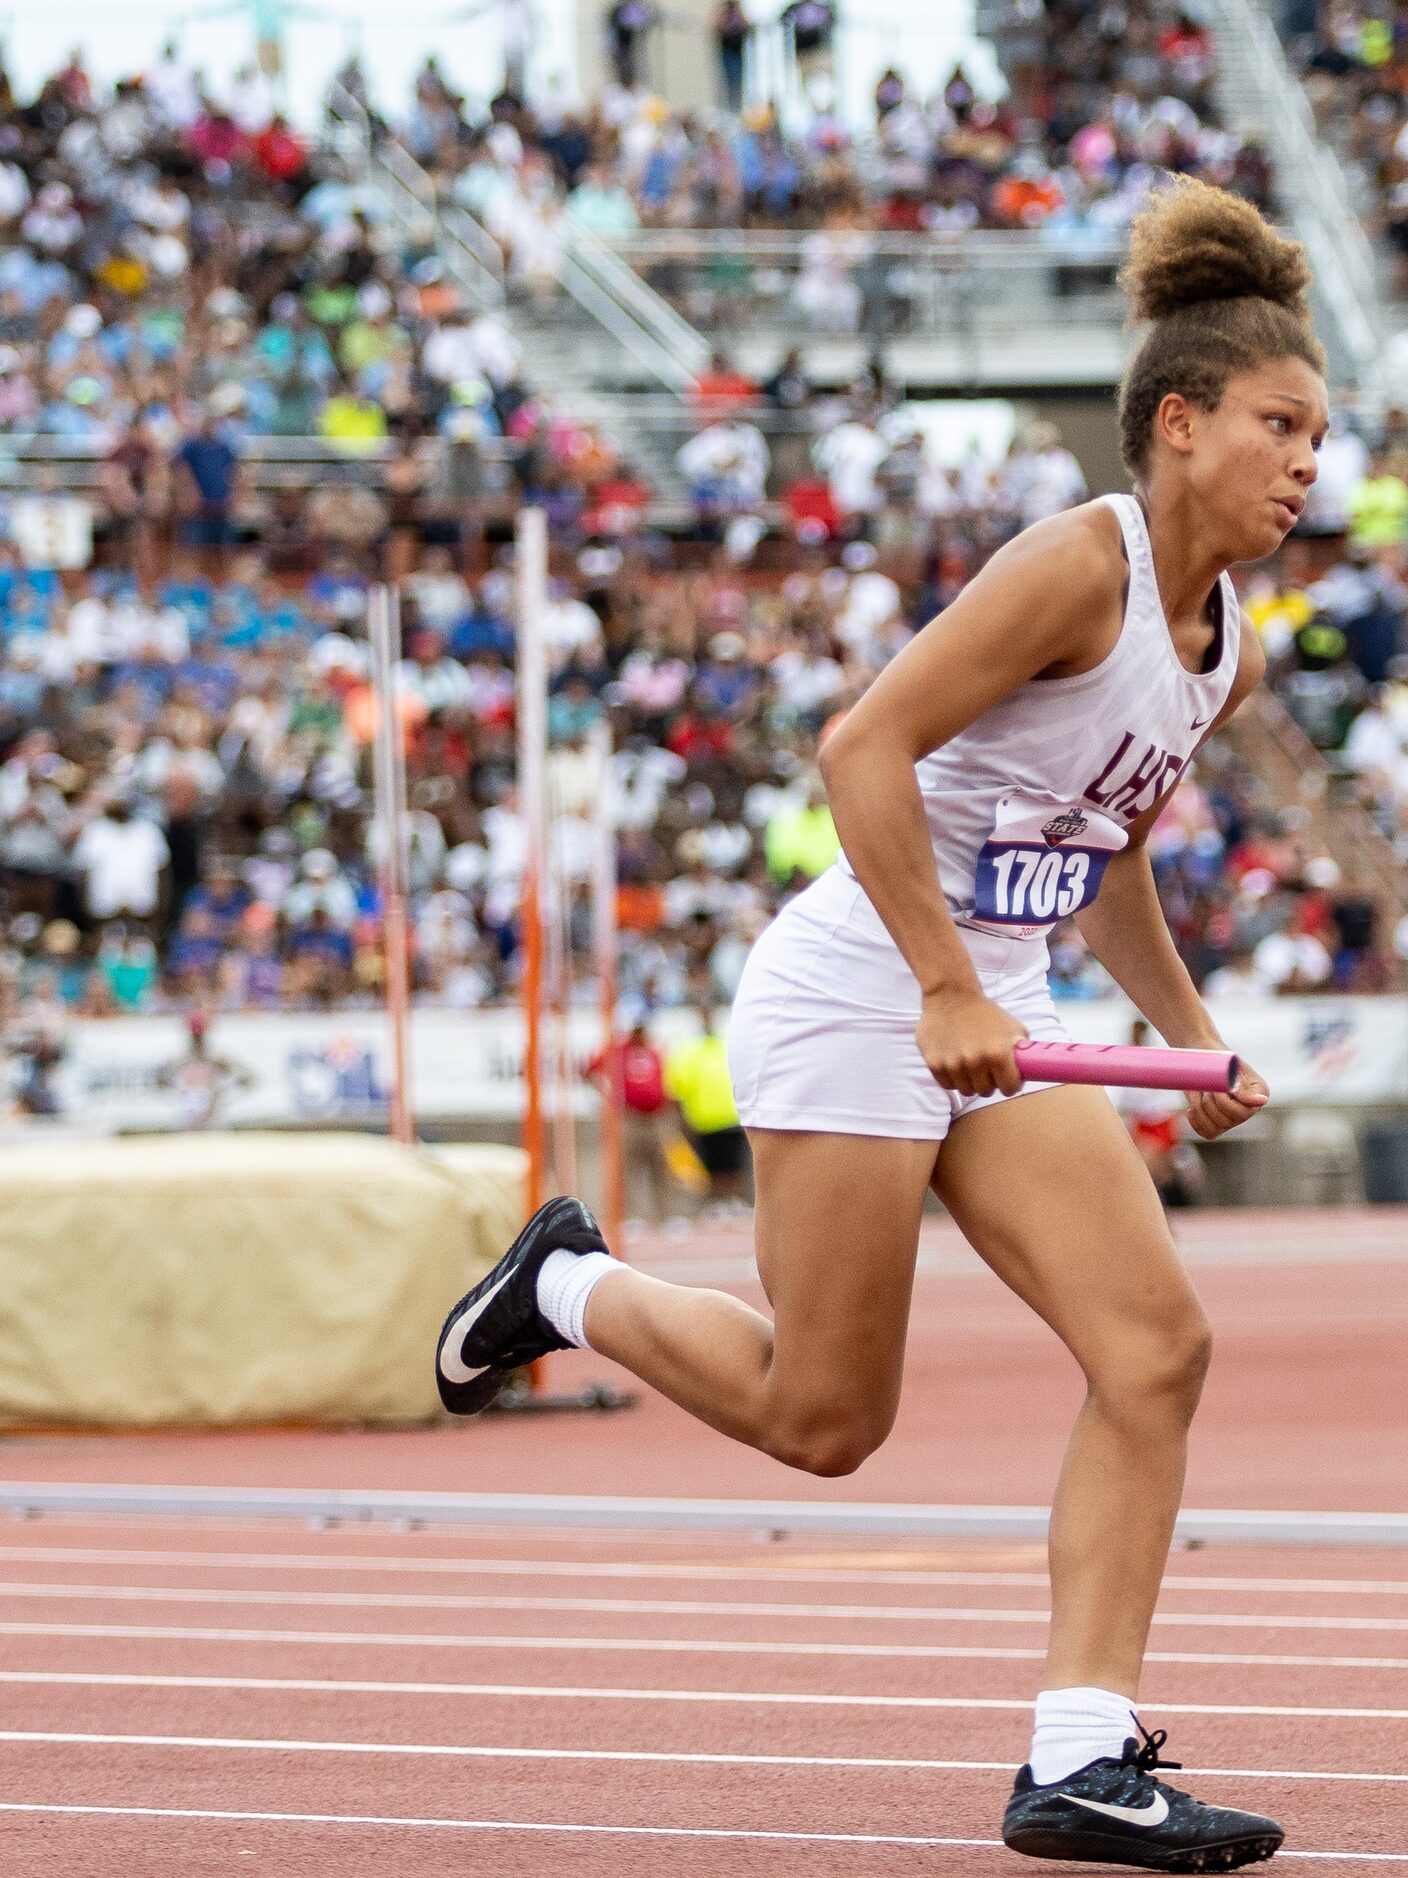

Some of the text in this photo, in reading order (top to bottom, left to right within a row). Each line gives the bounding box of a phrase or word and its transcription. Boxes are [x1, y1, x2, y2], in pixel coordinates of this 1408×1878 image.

[1082, 730, 1185, 820] LHS
[1043, 821, 1087, 834] STATE
[992, 849, 1090, 918] 1703
